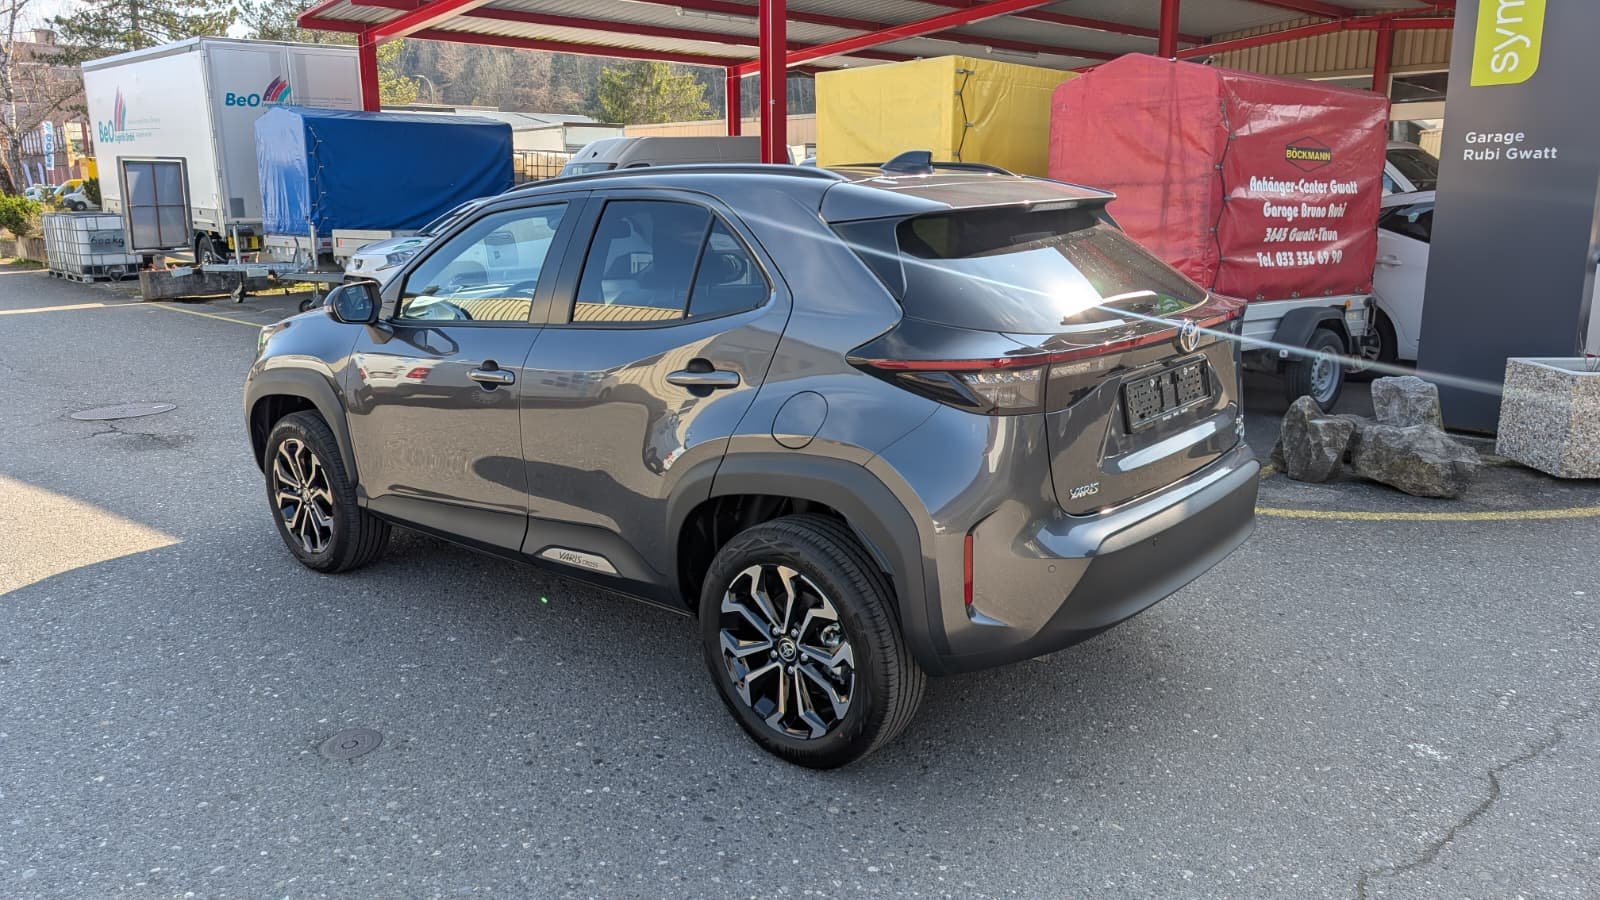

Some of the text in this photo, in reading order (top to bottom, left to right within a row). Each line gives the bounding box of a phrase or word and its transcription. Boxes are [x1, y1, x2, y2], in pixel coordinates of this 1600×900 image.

[225, 92, 260, 107] BeO
[98, 119, 115, 143] BeO
[1465, 132, 1525, 144] Garage
[1286, 148, 1330, 160] BÖCKMANN
[1463, 147, 1558, 161] Rubi Gwatt
[1250, 176, 1357, 195] Anhänger-Center Gwatt
[1263, 202, 1298, 221] Garage
[1301, 202, 1327, 218] Bruno
[1264, 227, 1337, 242] 3645 Gwatt-Thun
[1256, 251, 1275, 267] Tel.
[1275, 251, 1294, 266] 033
[1296, 250, 1316, 266] 336
[1317, 250, 1329, 264] 69
